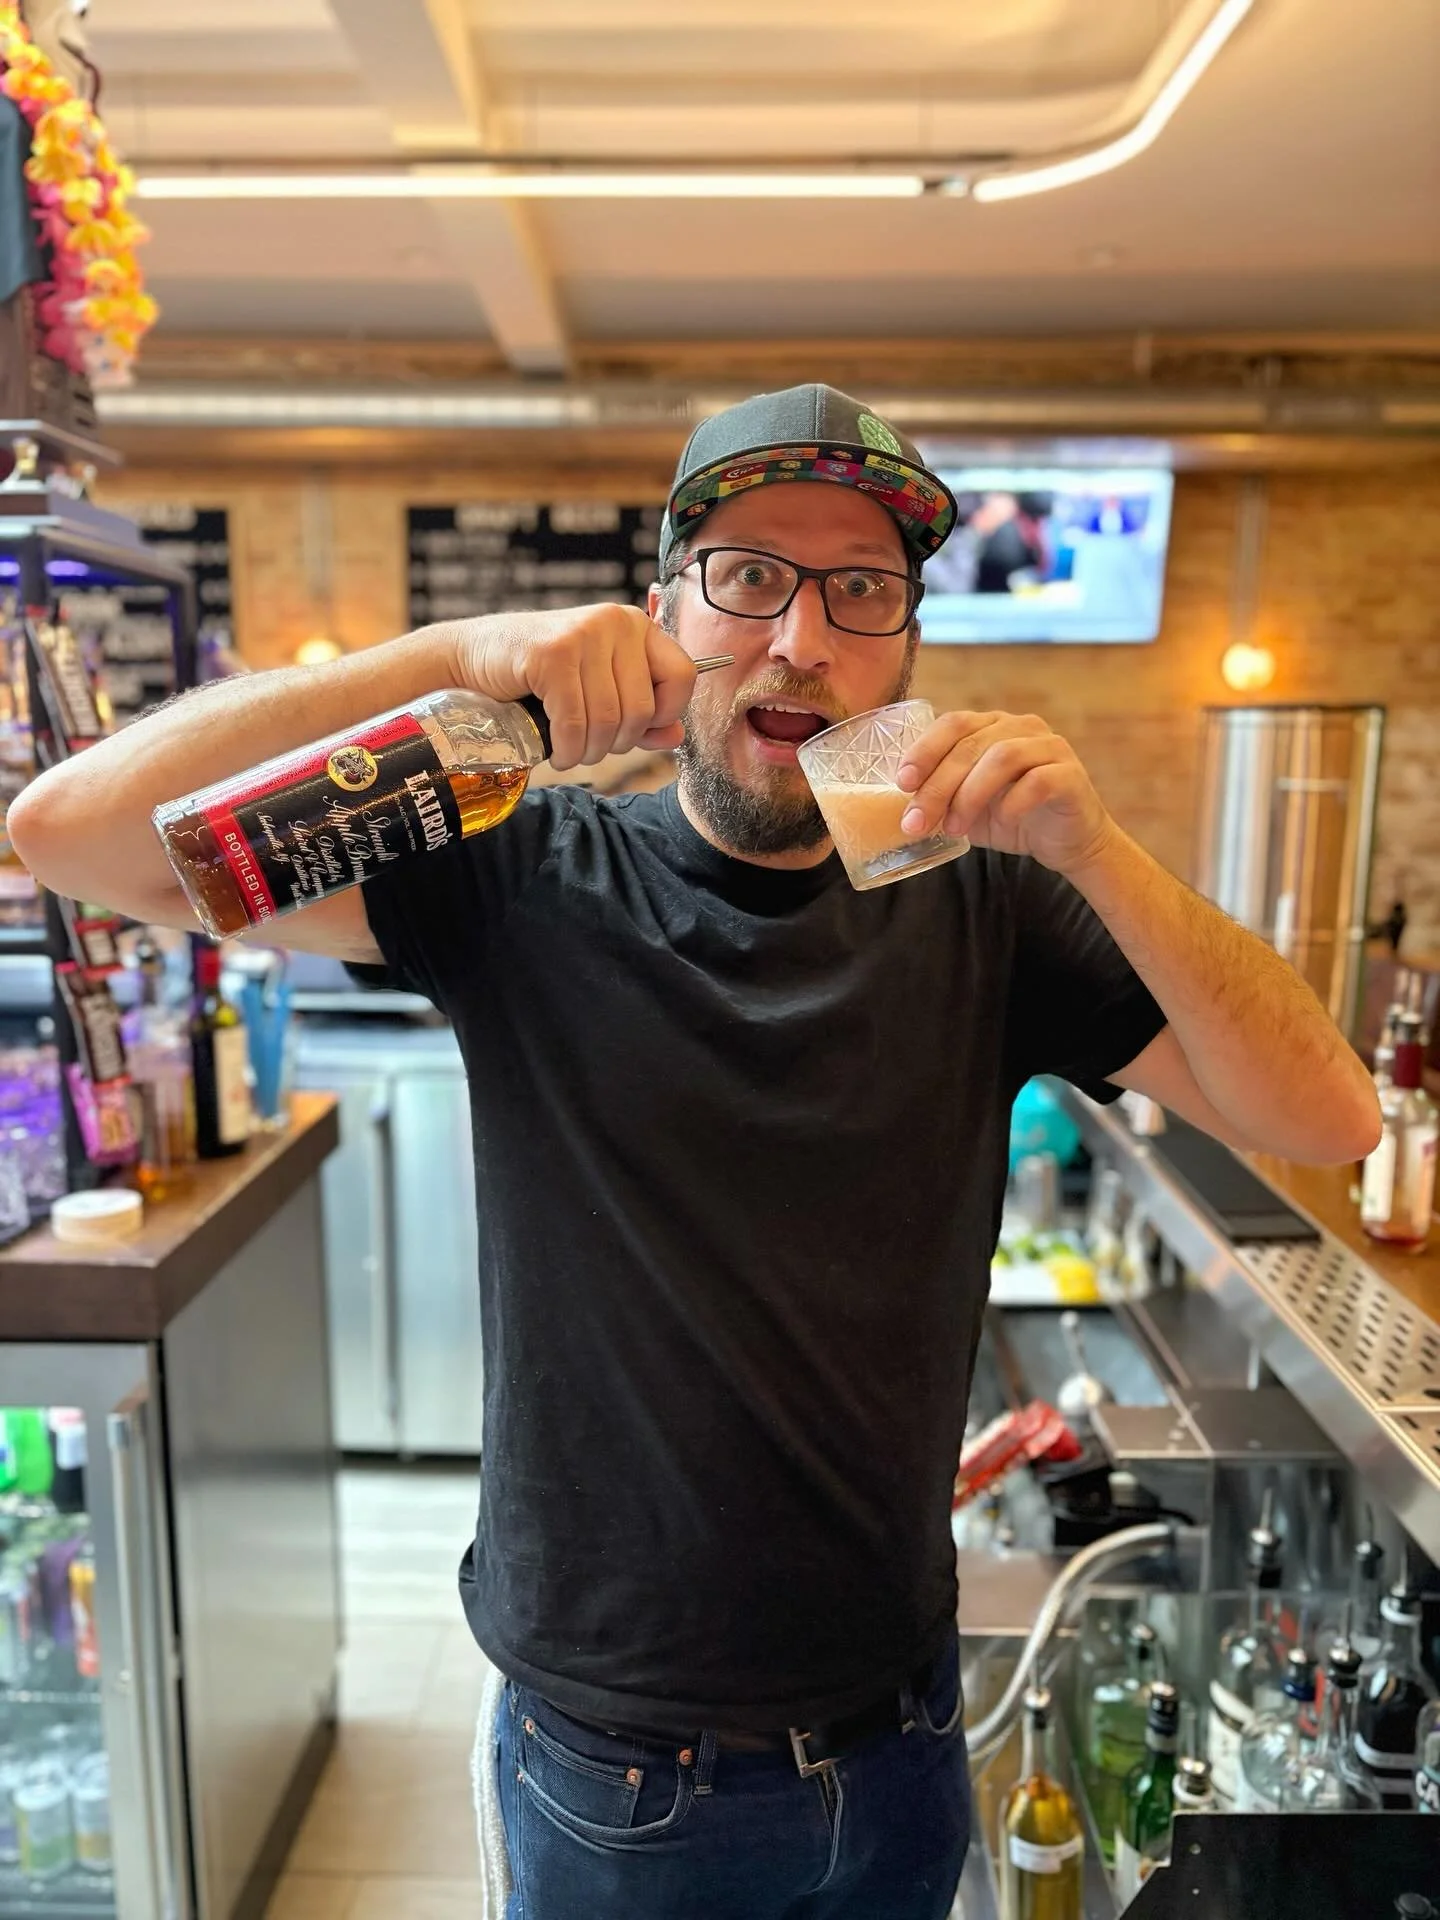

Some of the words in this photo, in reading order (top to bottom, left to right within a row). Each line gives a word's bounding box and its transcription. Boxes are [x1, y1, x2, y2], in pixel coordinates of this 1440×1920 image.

[323, 796, 367, 846] Apple
[404, 770, 453, 851] LAIRD'S
[288, 820, 315, 854] Laird
[316, 836, 342, 875] Distilled
[365, 811, 399, 862] Straight
[224, 832, 260, 891] BOTTLED
[253, 893, 266, 905] IN
[258, 905, 273, 924] BON
